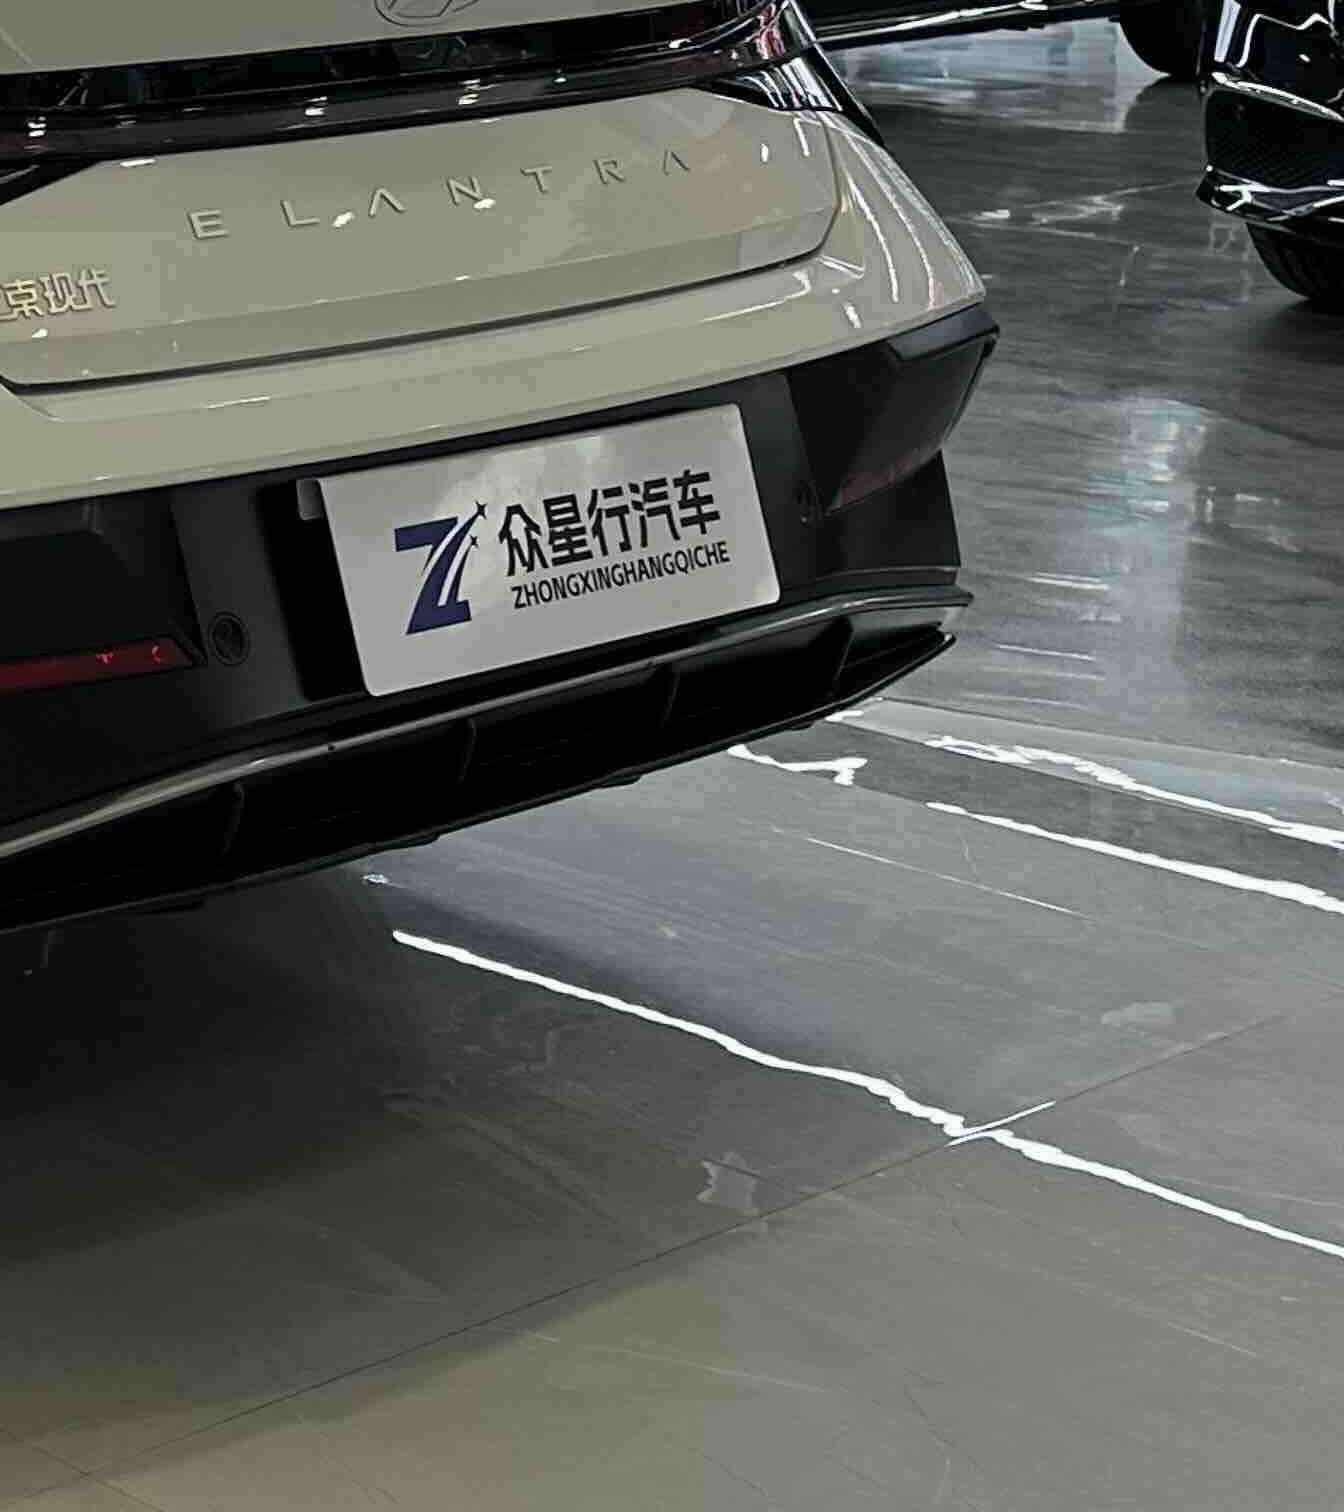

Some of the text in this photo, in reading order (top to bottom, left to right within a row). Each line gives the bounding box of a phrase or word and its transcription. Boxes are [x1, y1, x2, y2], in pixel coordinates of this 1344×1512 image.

[187, 148, 689, 240] ELANTRA
[498, 469, 721, 576] 众星行汽车
[512, 540, 730, 609] ZHONGXINGHANGQICHE
